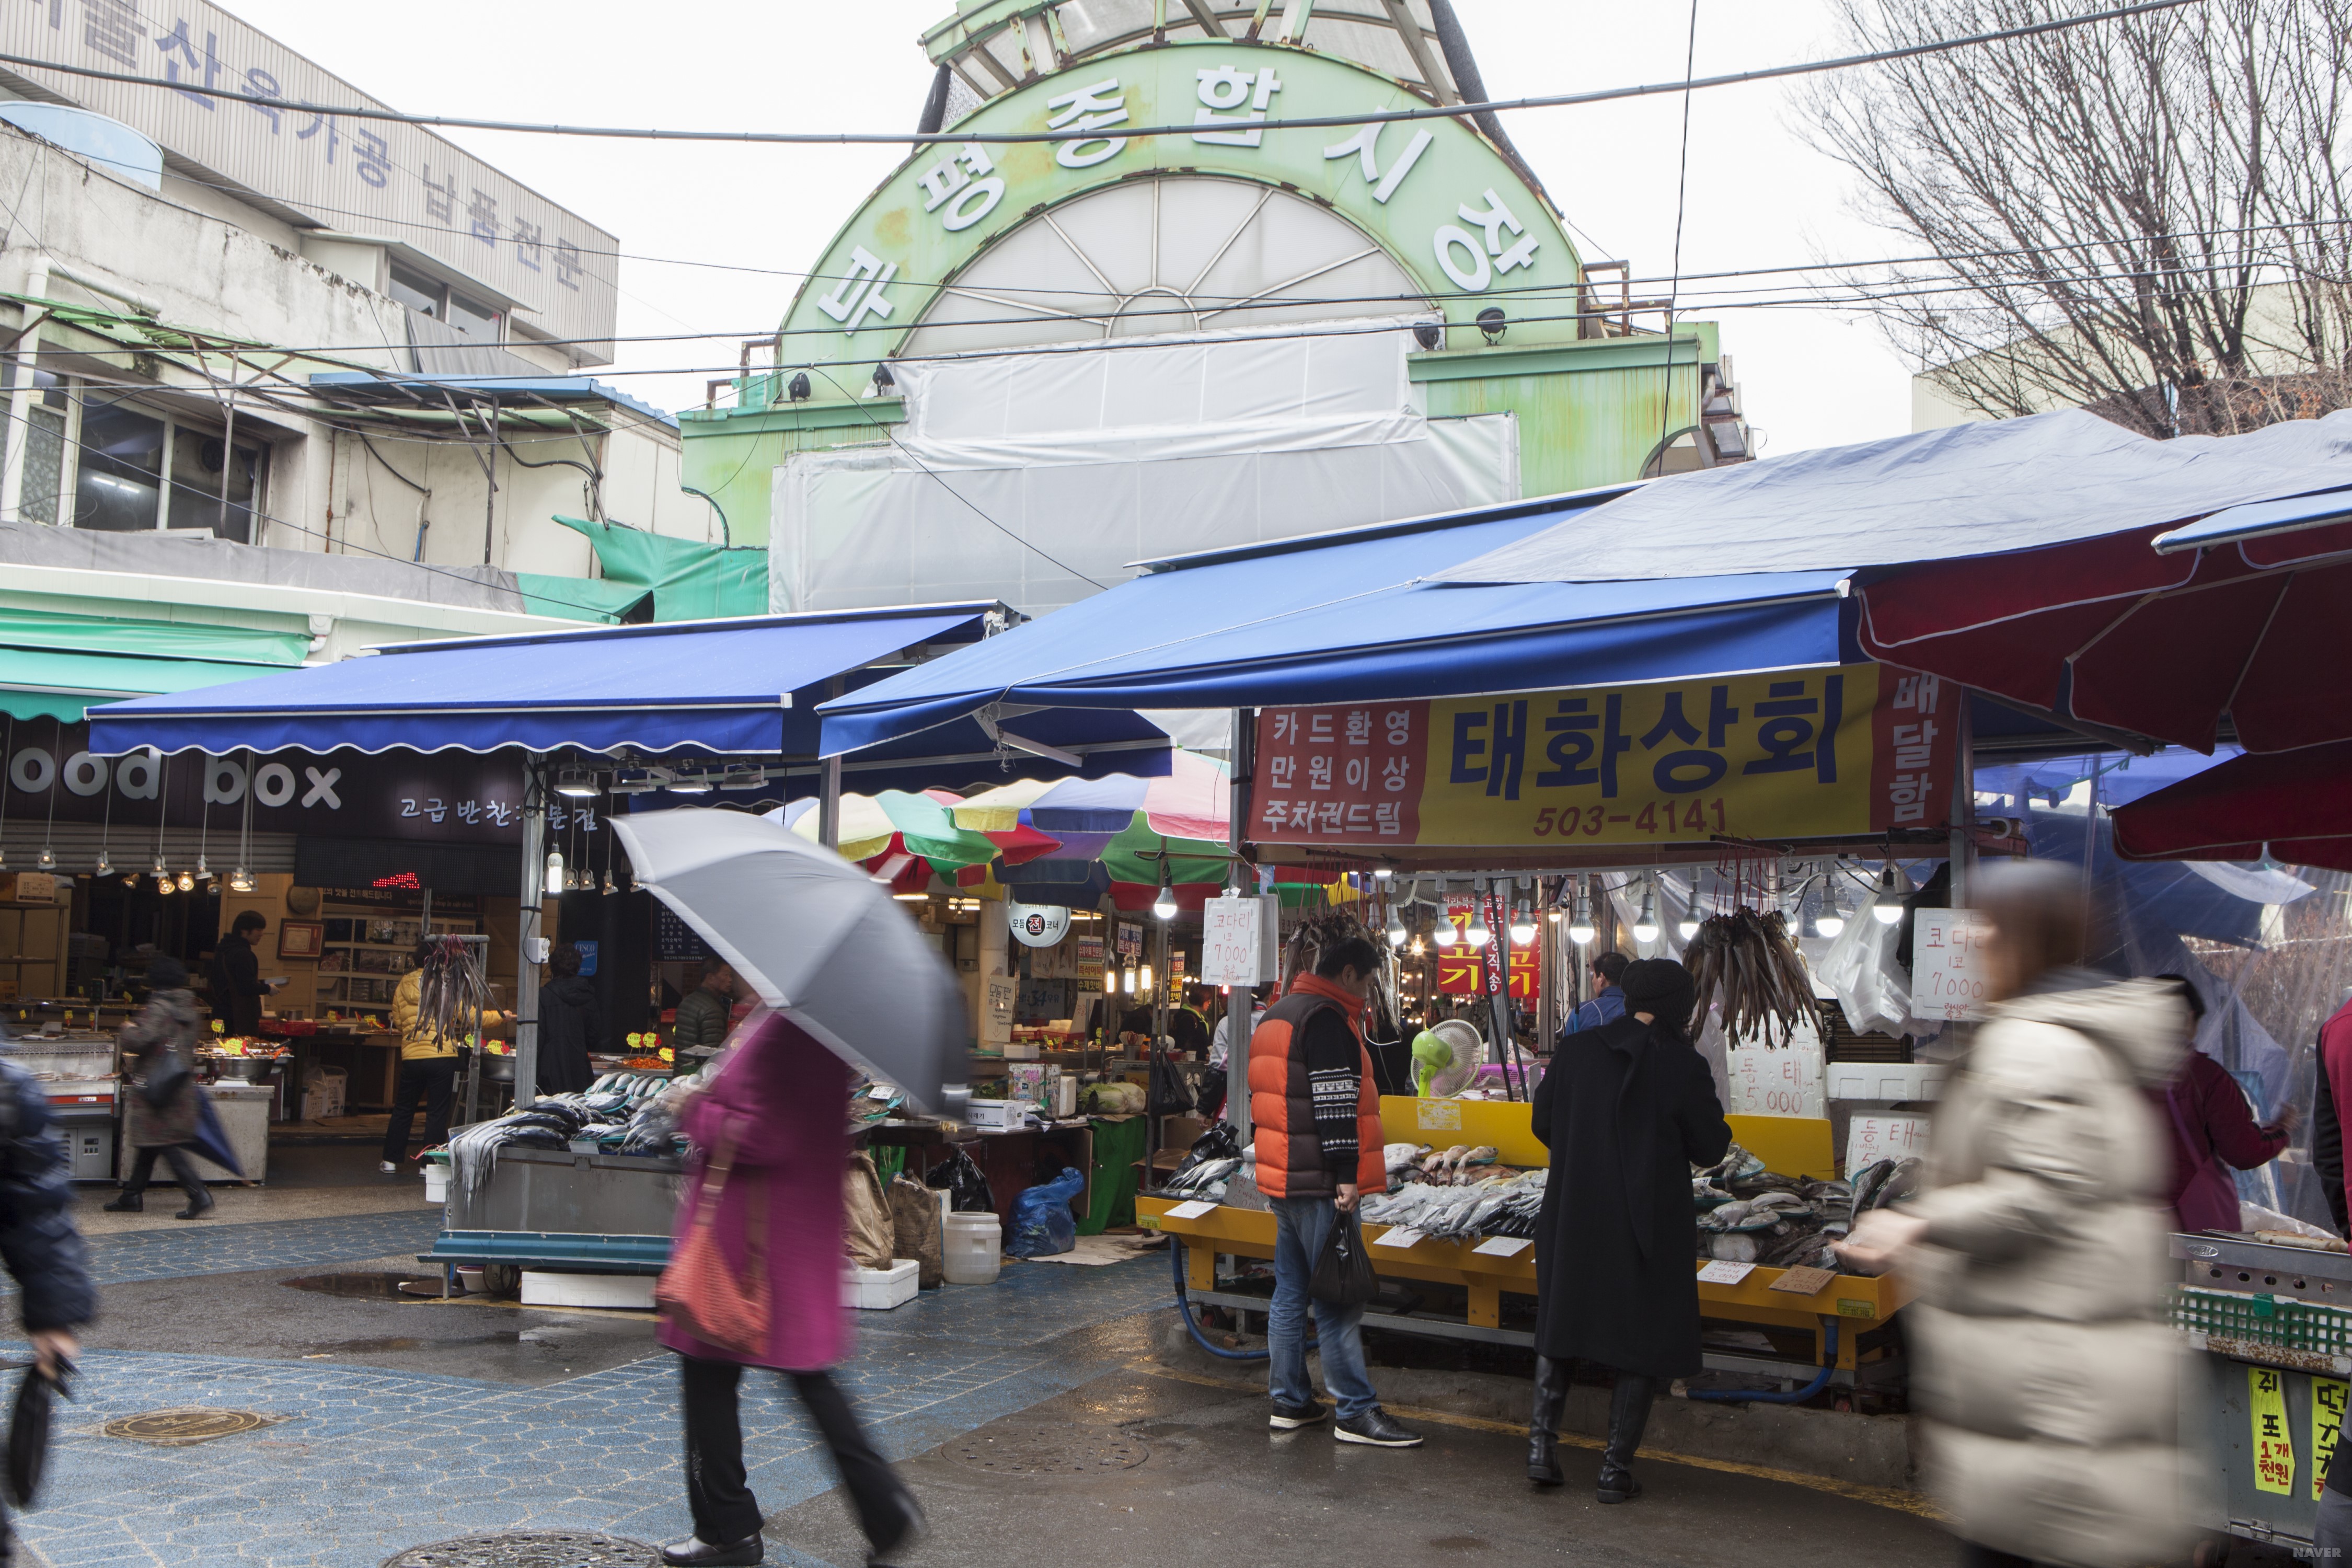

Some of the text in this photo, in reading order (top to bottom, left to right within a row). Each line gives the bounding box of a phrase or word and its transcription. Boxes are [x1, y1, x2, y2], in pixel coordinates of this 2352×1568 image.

[816, 65, 1540, 337] 부평종합시장
[1450, 674, 1844, 801] 태화상회
[1889, 673, 1939, 823] 배달함
[0, 747, 341, 810] ood box
[400, 798, 598, 832] 고급반찬문점
[1534, 798, 1726, 836] 503-4141
[1012, 917, 1059, 933] 모듬 전 코너
[1214, 912, 1250, 931] 코다리
[1120, 928, 1142, 942] 어묵 핫바
[1079, 946, 1102, 958] 수제어묵 전문점
[1214, 944, 1247, 963] 7000
[1079, 965, 1102, 976] 즉석어묵
[989, 984, 1011, 1000] 모듬전
[1078, 979, 1102, 991] 수제핫바
[1172, 978, 1182, 988] 어묵
[1932, 971, 1984, 999] 7000
[1170, 991, 1181, 1001] 핫바
[1944, 1003, 1969, 1011] 러시아
[1945, 1010, 1965, 1020] 속초
[1744, 1087, 1803, 1114] 5000
[1860, 1120, 1915, 1150] 동태
[1774, 1281, 1818, 1292] 5000
[2258, 1370, 2281, 1438] 쥐포
[2261, 1442, 2289, 1458] 1개
[2258, 1460, 2289, 1486] 천원
